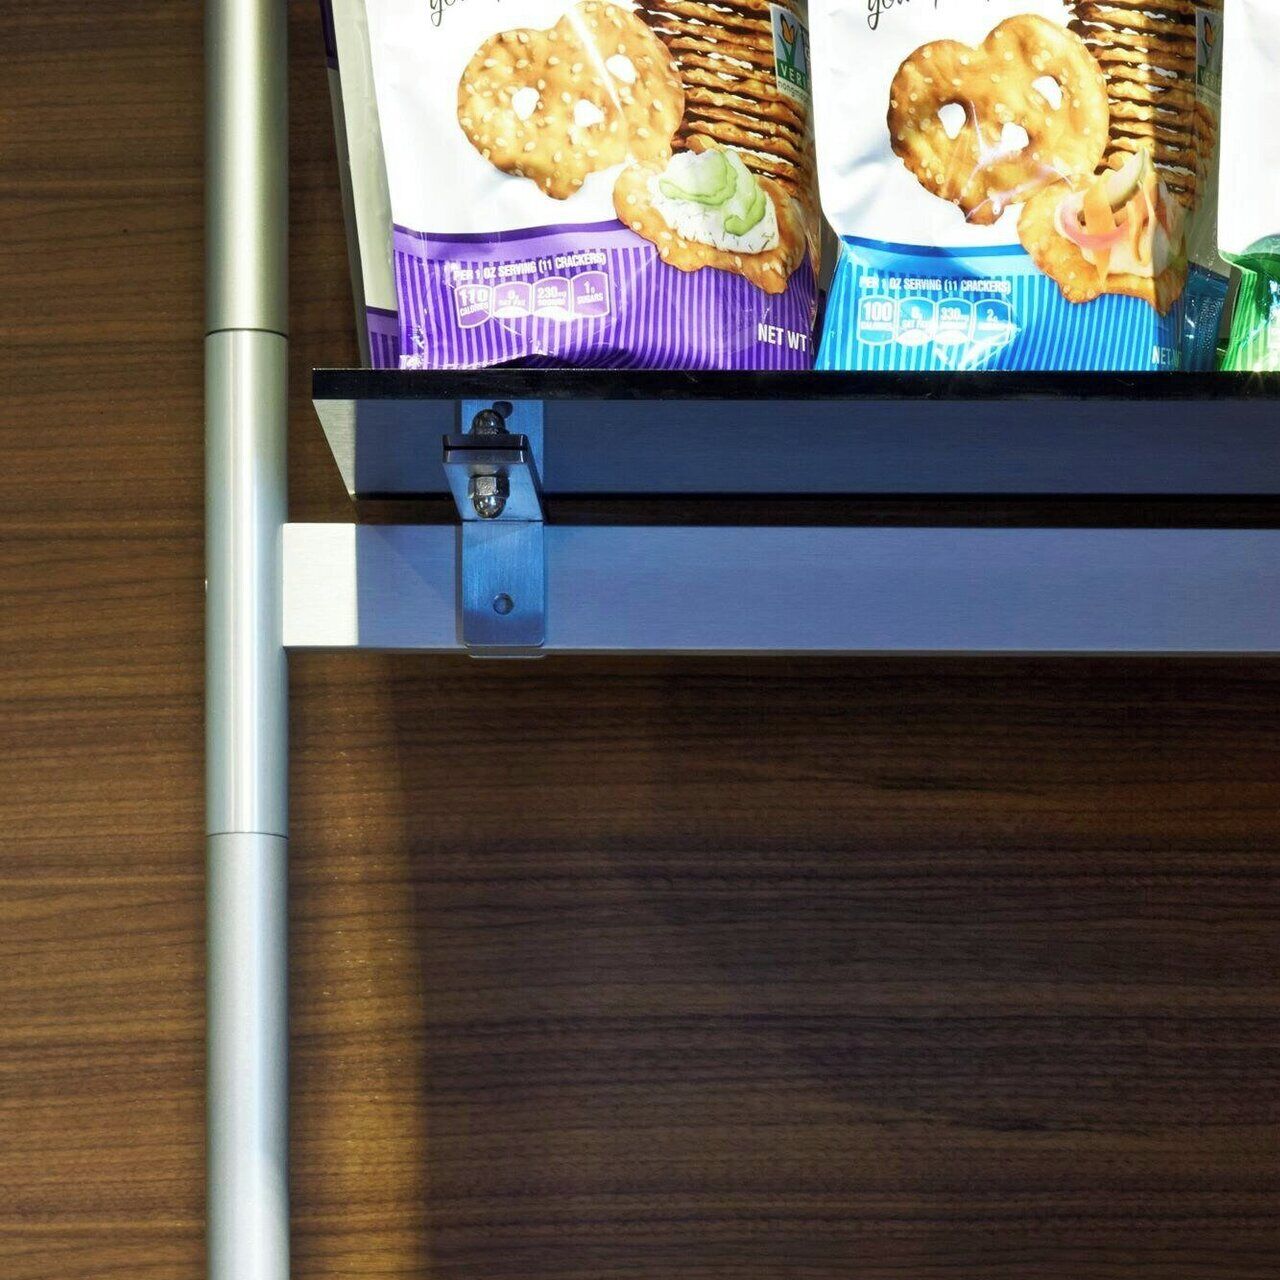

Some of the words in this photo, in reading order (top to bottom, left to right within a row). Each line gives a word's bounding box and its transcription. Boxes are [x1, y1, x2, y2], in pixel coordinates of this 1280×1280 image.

[483, 266, 497, 279] OZ
[498, 261, 537, 276] SERVING
[904, 278, 942, 291] SERVING
[944, 280, 958, 293] (11
[459, 288, 488, 306] 110
[863, 301, 893, 321] 100
[758, 322, 784, 346] NET
[787, 330, 807, 352] WT
